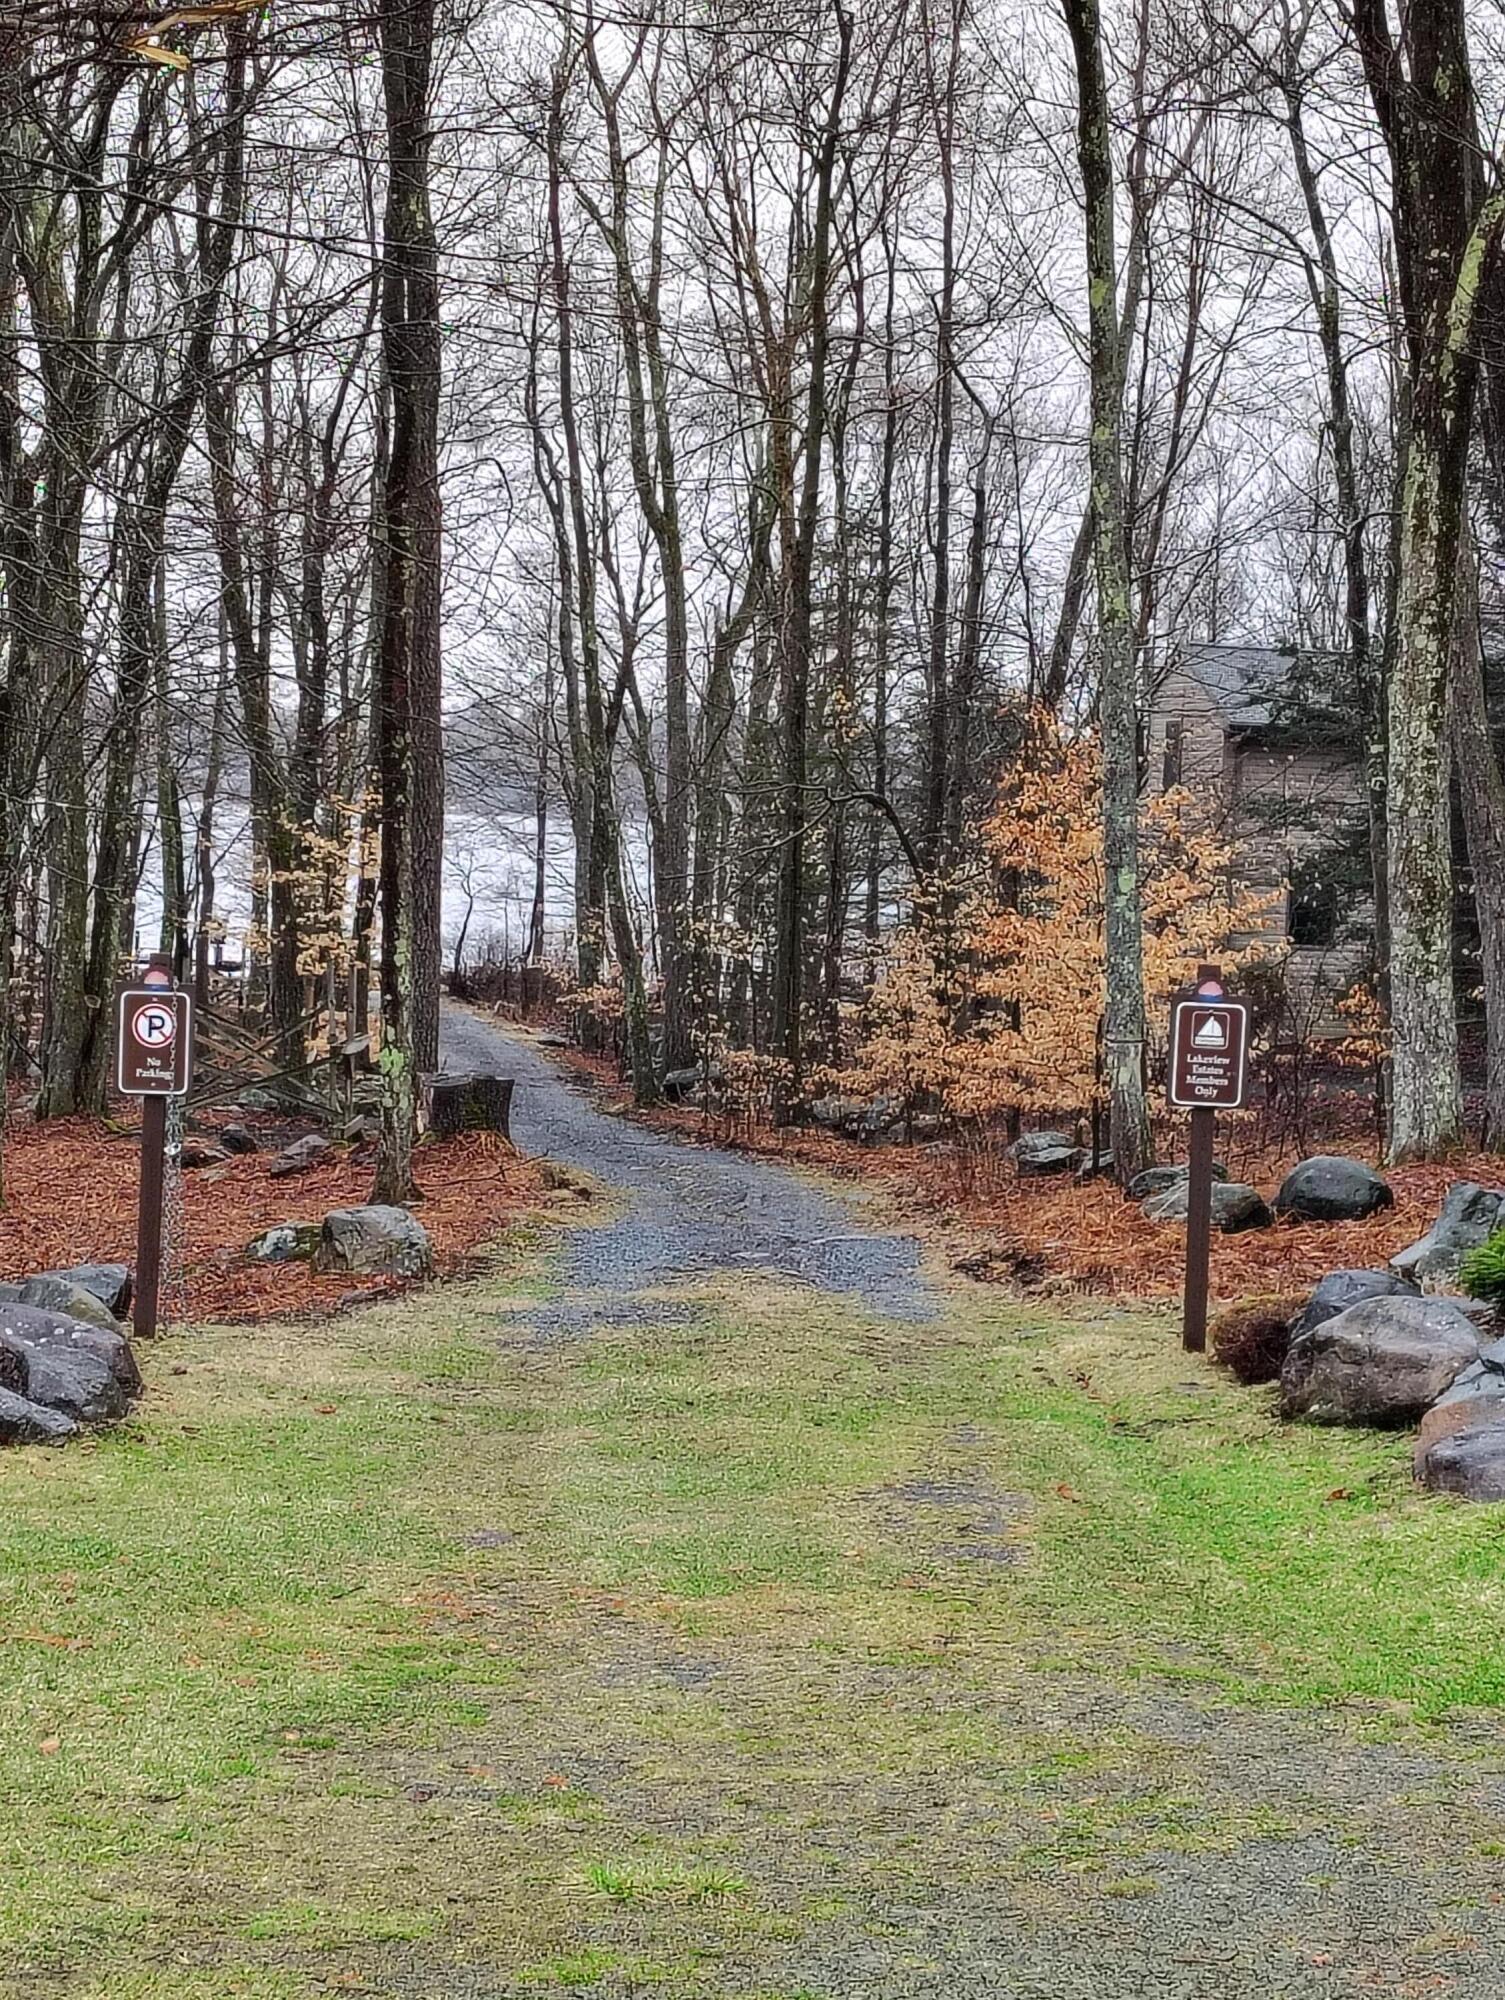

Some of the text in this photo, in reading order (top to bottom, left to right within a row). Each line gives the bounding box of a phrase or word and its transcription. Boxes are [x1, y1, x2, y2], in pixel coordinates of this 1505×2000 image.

[146, 1057, 161, 1067] No
[1187, 1053, 1230, 1065] Lakeview
[135, 1068, 174, 1081] Parking
[1192, 1064, 1224, 1075] Estates
[1186, 1074, 1229, 1086] Members
[1195, 1086, 1218, 1098] Only
